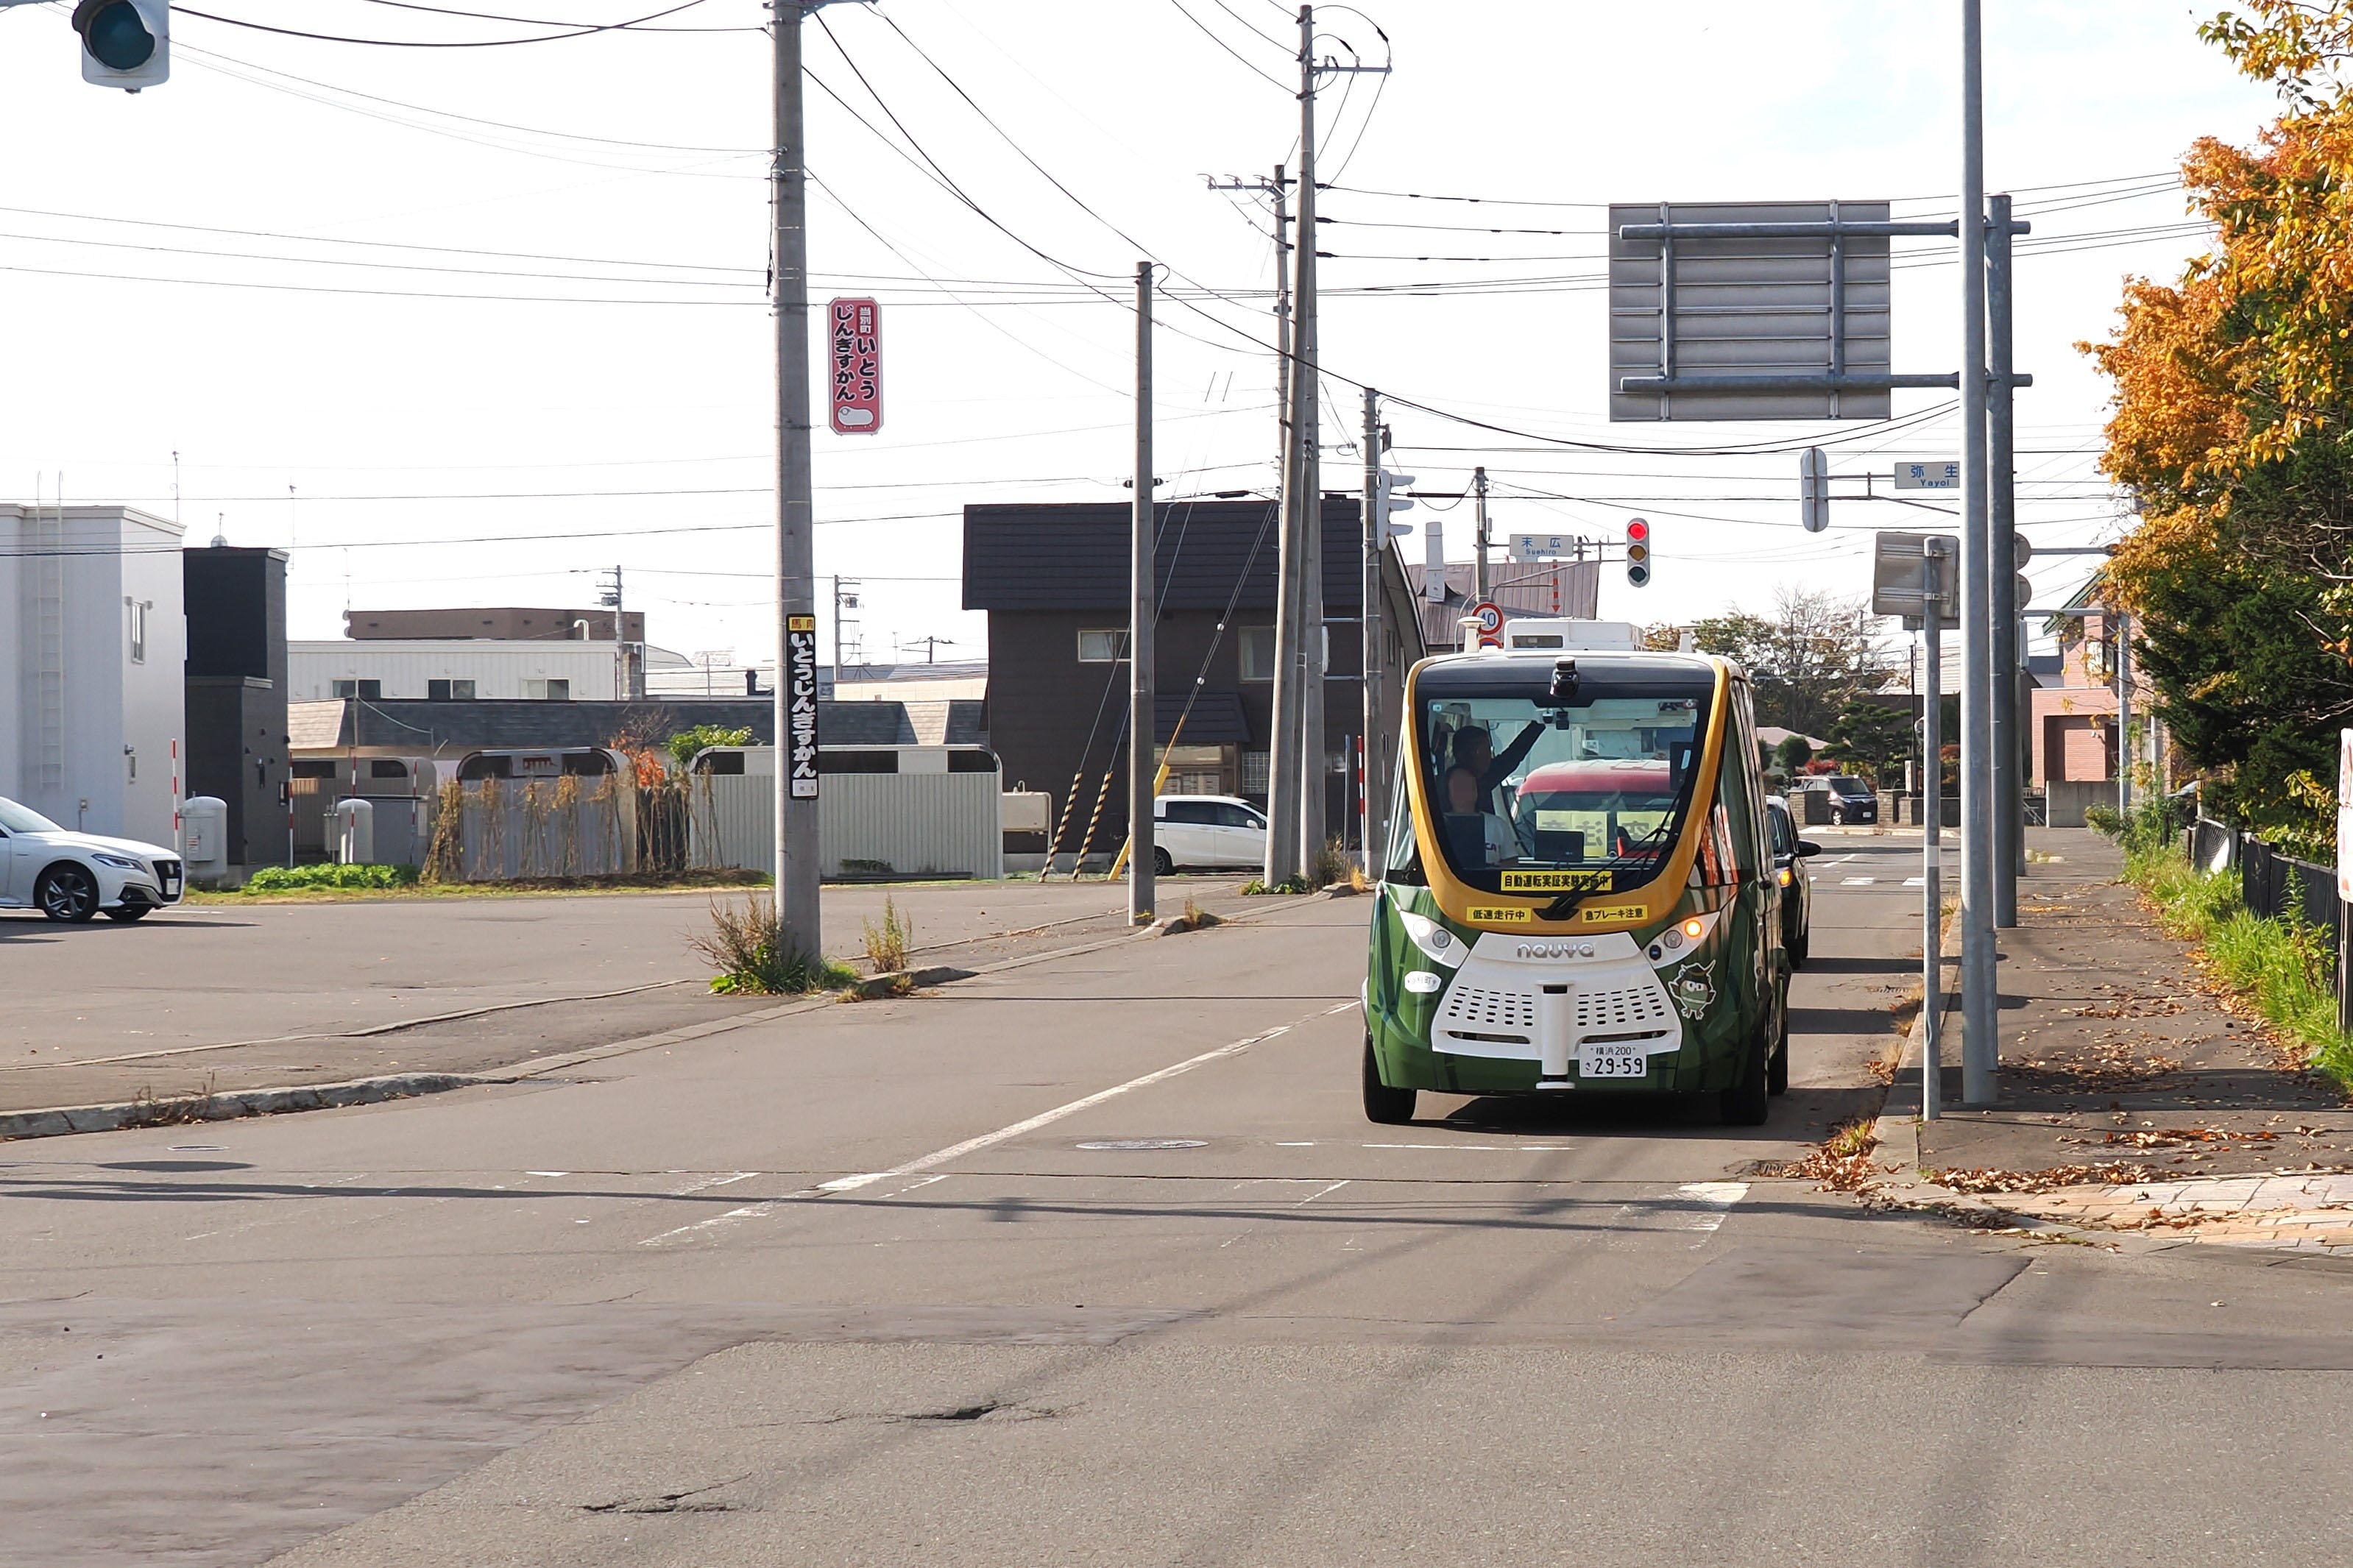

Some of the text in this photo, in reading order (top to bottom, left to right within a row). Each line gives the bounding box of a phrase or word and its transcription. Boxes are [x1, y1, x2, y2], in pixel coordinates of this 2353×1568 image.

[859, 306, 872, 334] 当別町
[835, 305, 855, 401] じんぎすかん
[857, 337, 876, 400] いとう
[1911, 464, 1958, 478] 弥生
[1920, 479, 1949, 488] Yayoi
[1521, 536, 1561, 548] 末広
[790, 633, 817, 778] いとうじんぎすかん
[1504, 874, 1608, 887] 自動運転実証実験実中
[1473, 909, 1525, 920] 低速走行中
[1585, 907, 1643, 920] 急ブレーキ注意
[1594, 1057, 1643, 1074] 29-59
